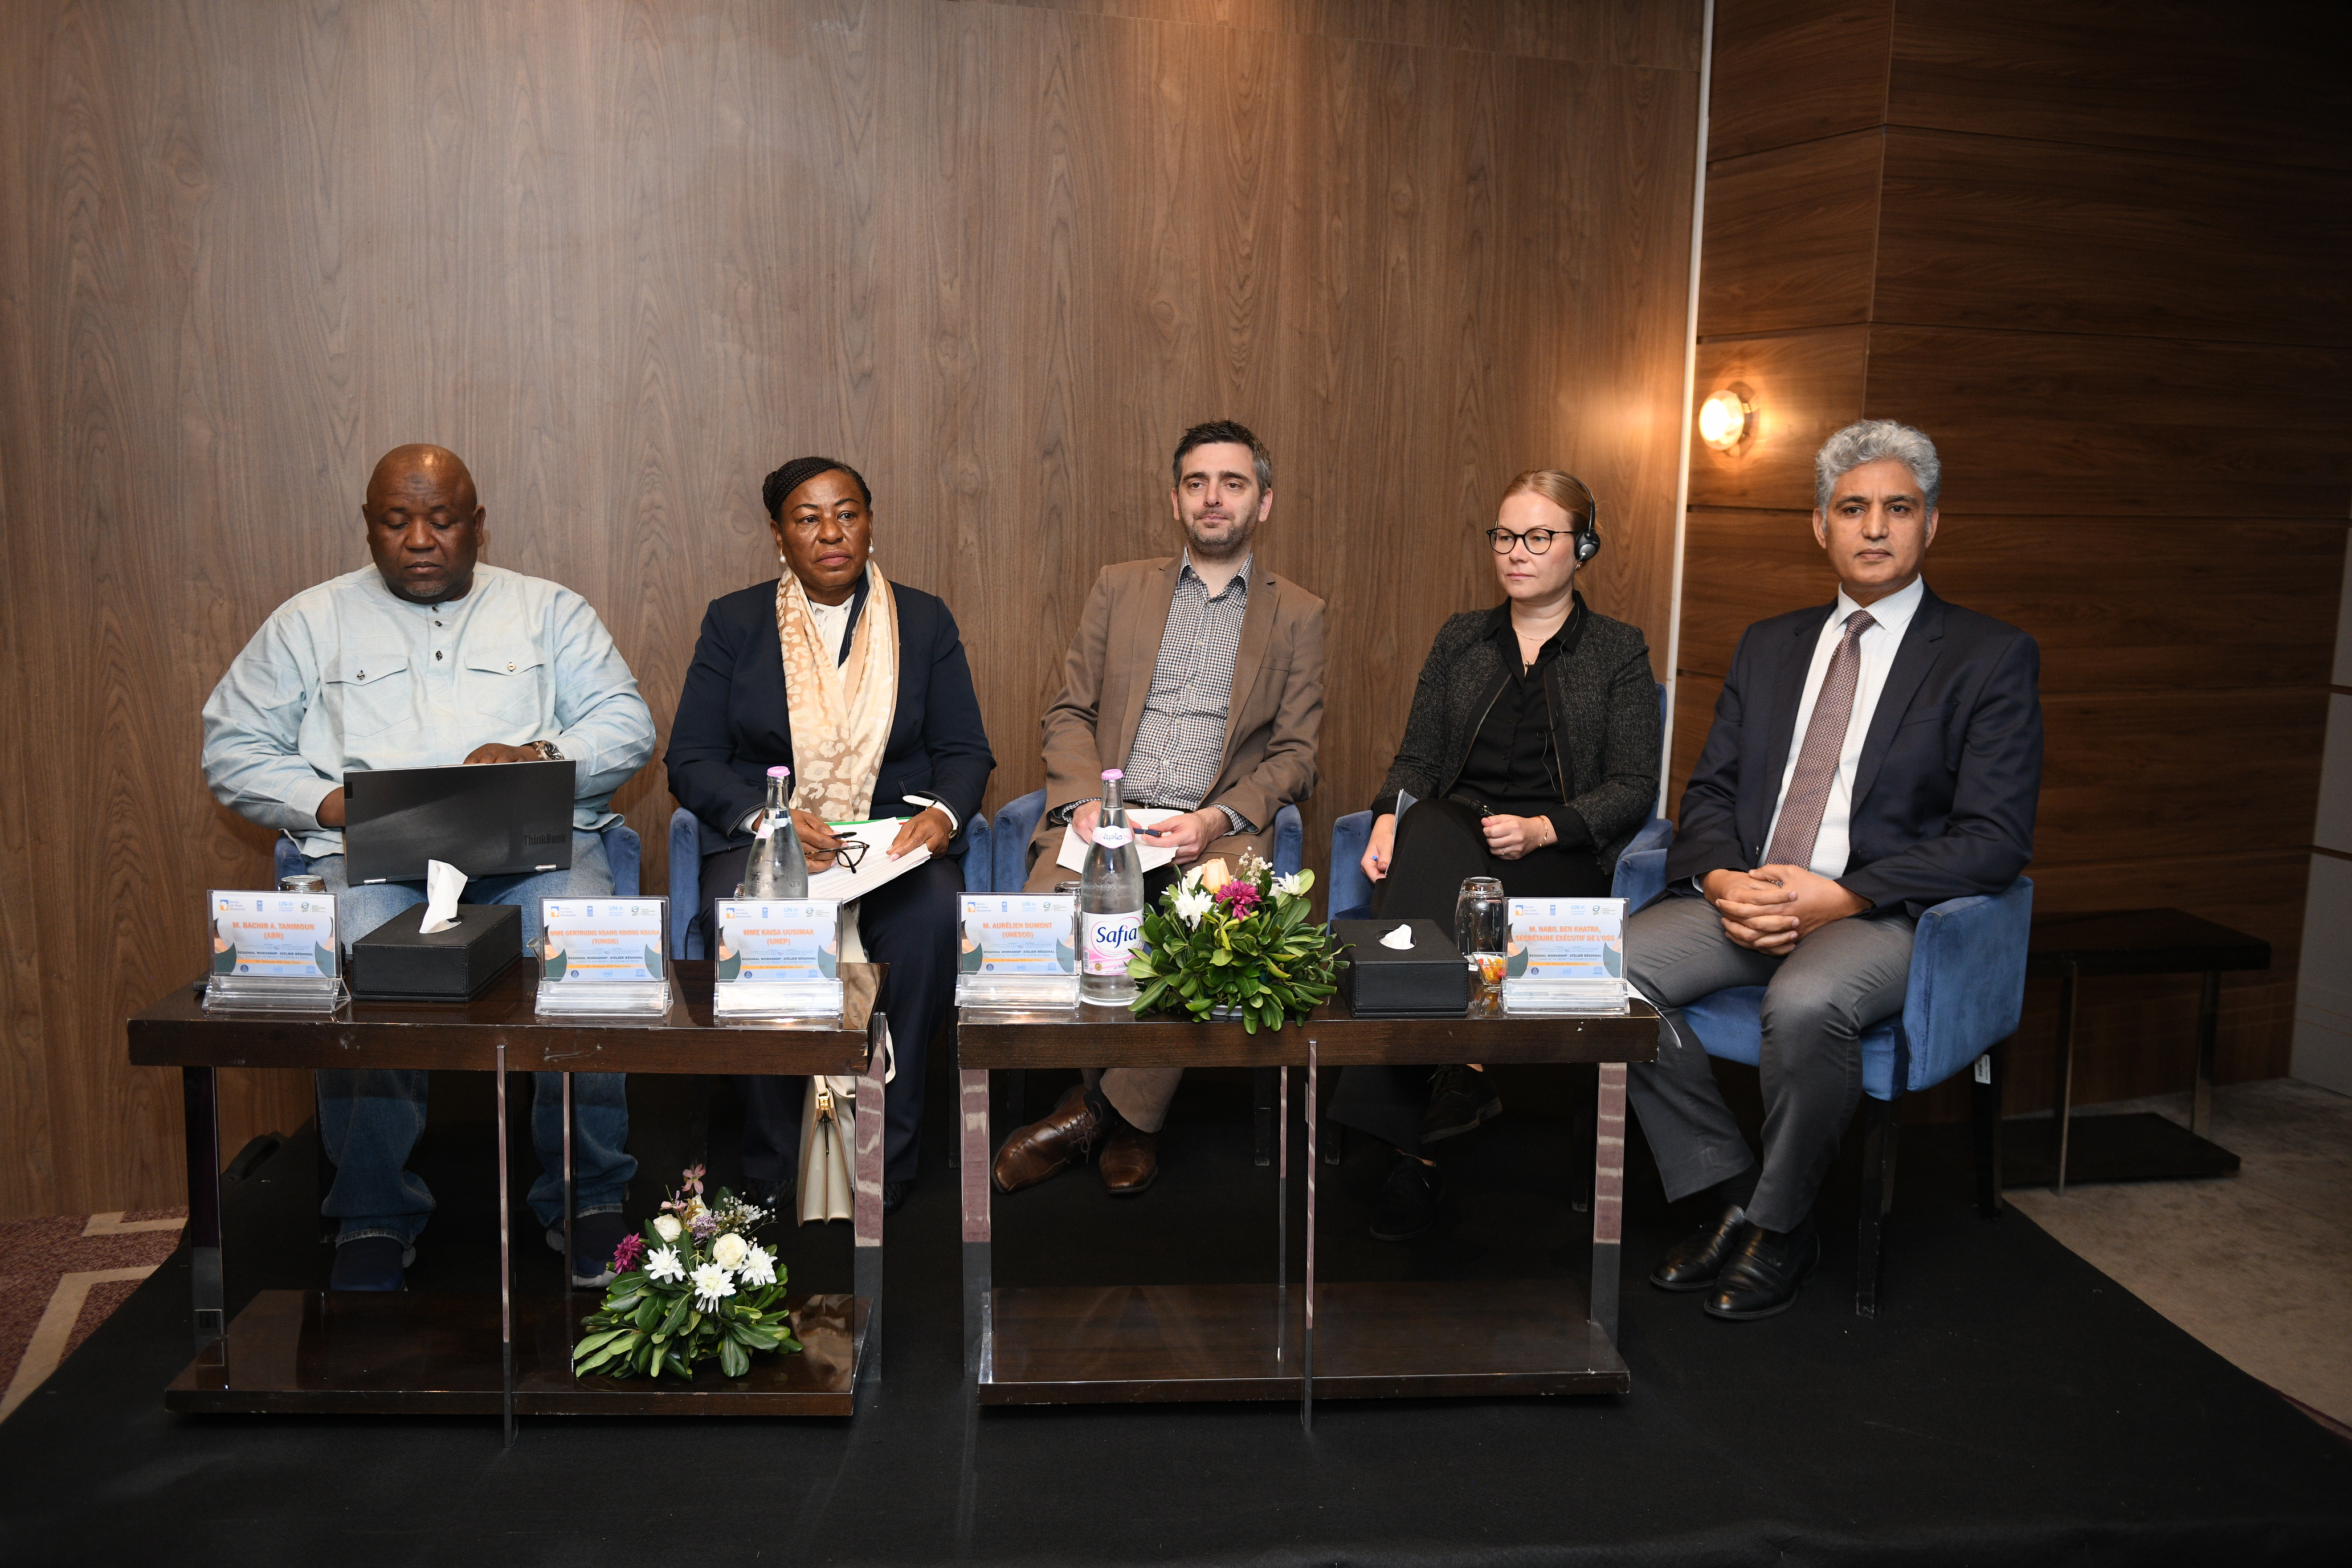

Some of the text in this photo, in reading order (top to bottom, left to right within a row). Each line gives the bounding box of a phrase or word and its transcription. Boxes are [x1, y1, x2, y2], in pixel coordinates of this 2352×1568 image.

[523, 834, 566, 846] ThinkBook
[1103, 832, 1122, 841] صافية
[1096, 925, 1137, 948] Safia
